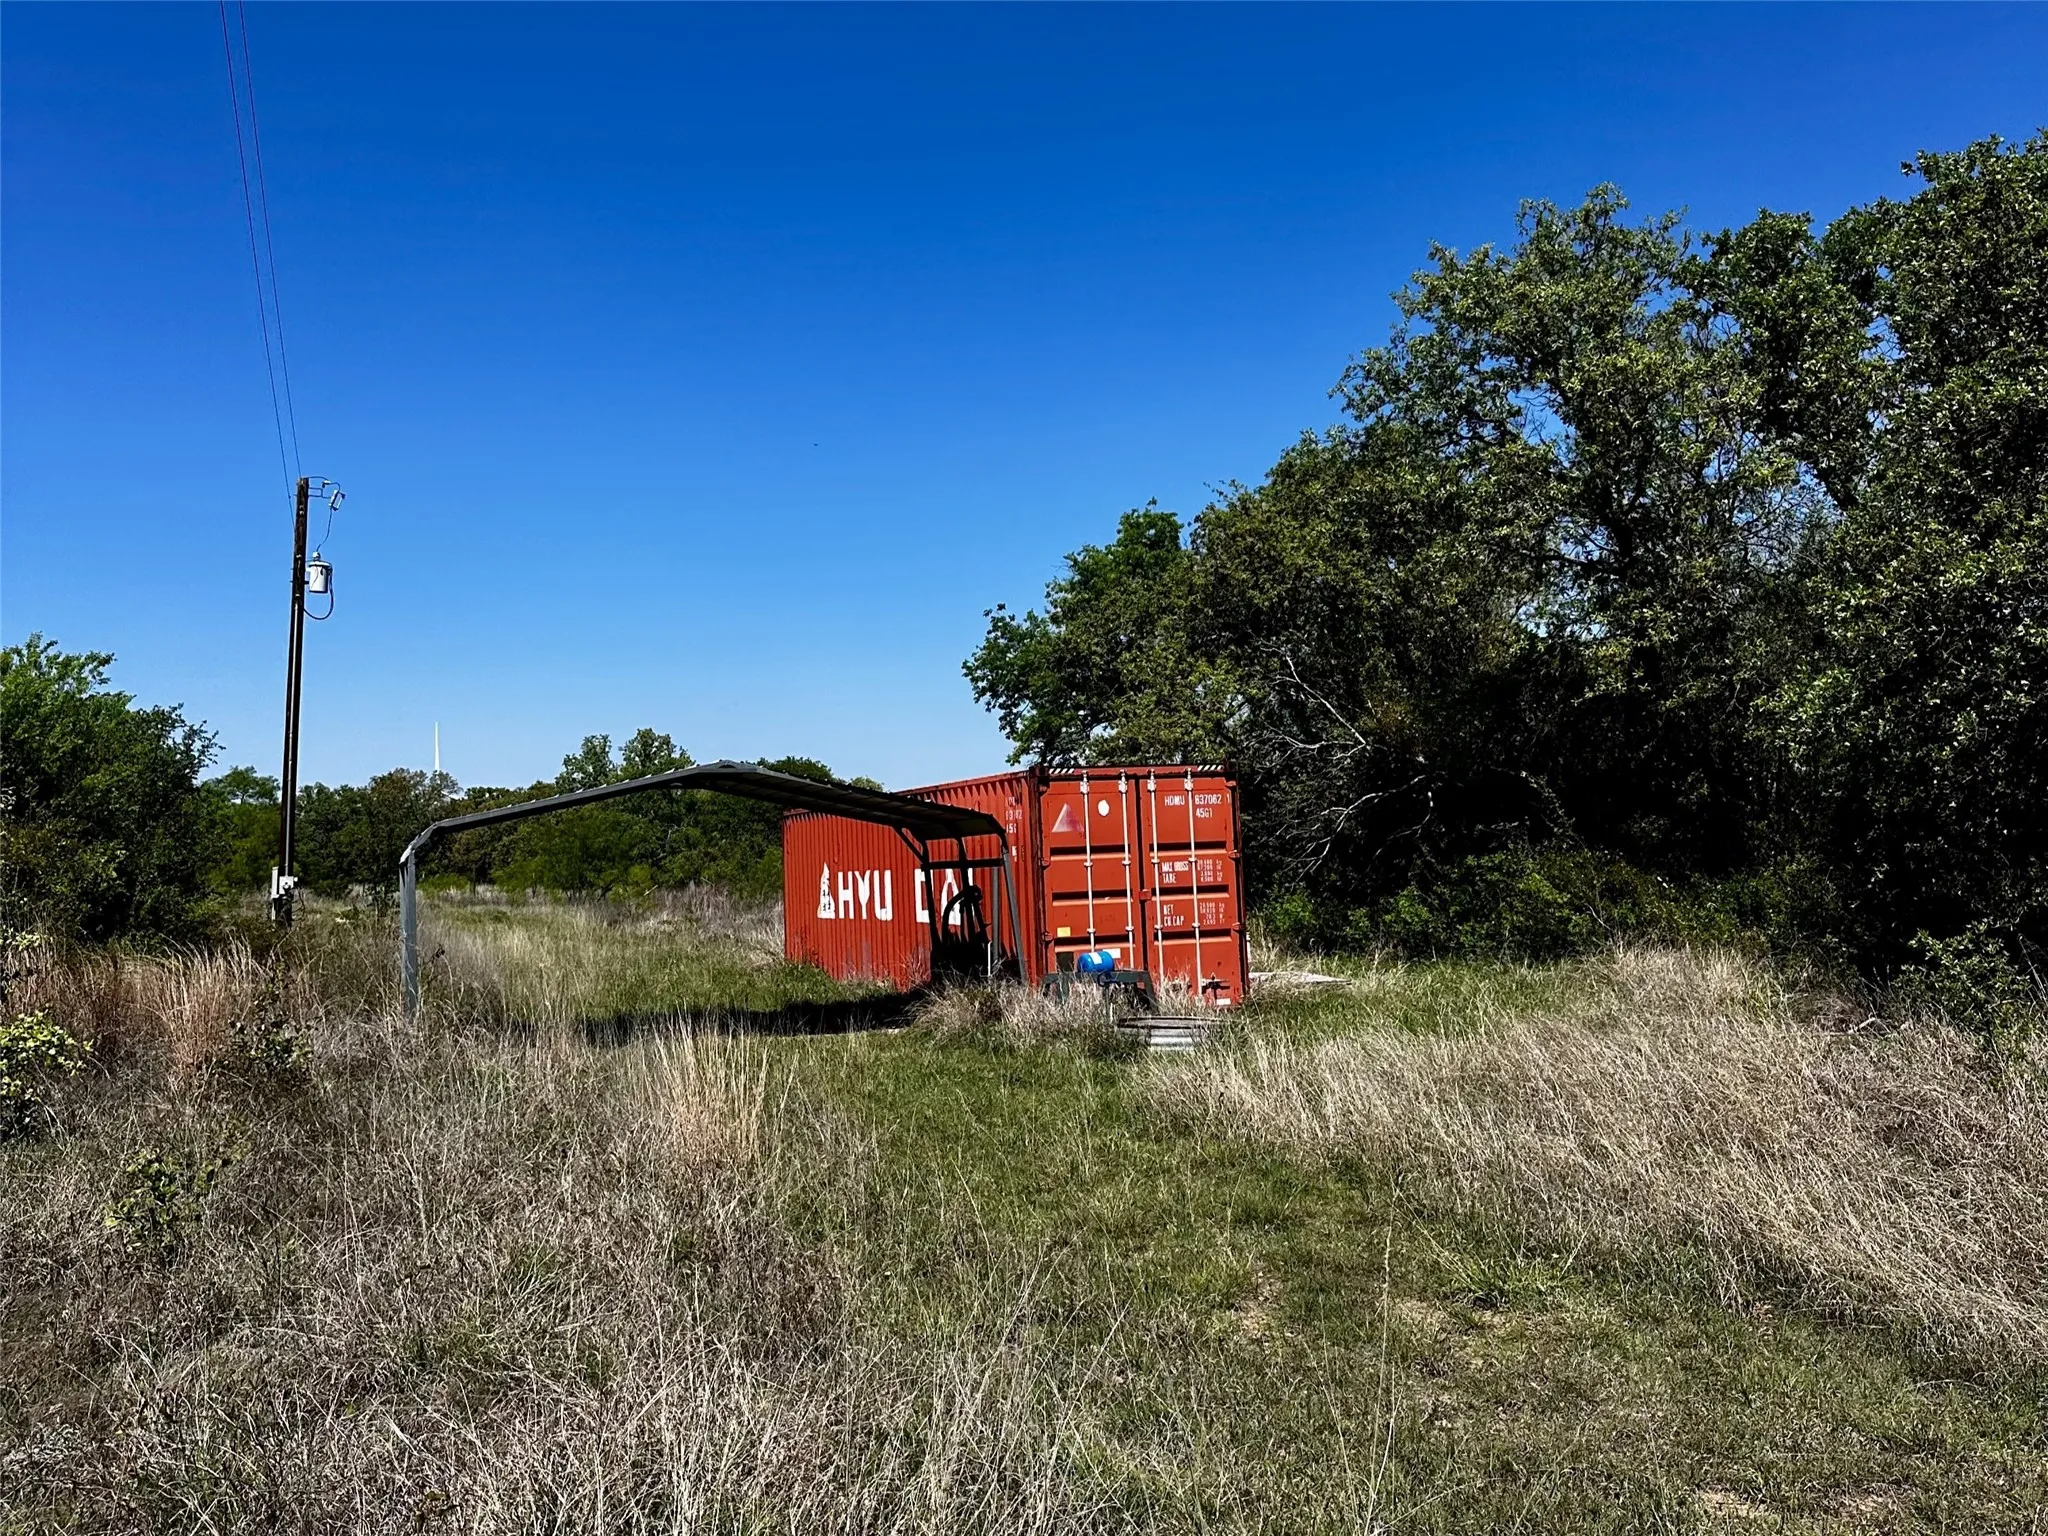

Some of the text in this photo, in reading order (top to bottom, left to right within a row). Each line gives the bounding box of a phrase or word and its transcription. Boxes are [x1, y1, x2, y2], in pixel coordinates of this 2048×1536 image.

[1194, 794, 1222, 805] 637062
[1195, 808, 1213, 818] 45G1
[838, 870, 893, 921] HYU
